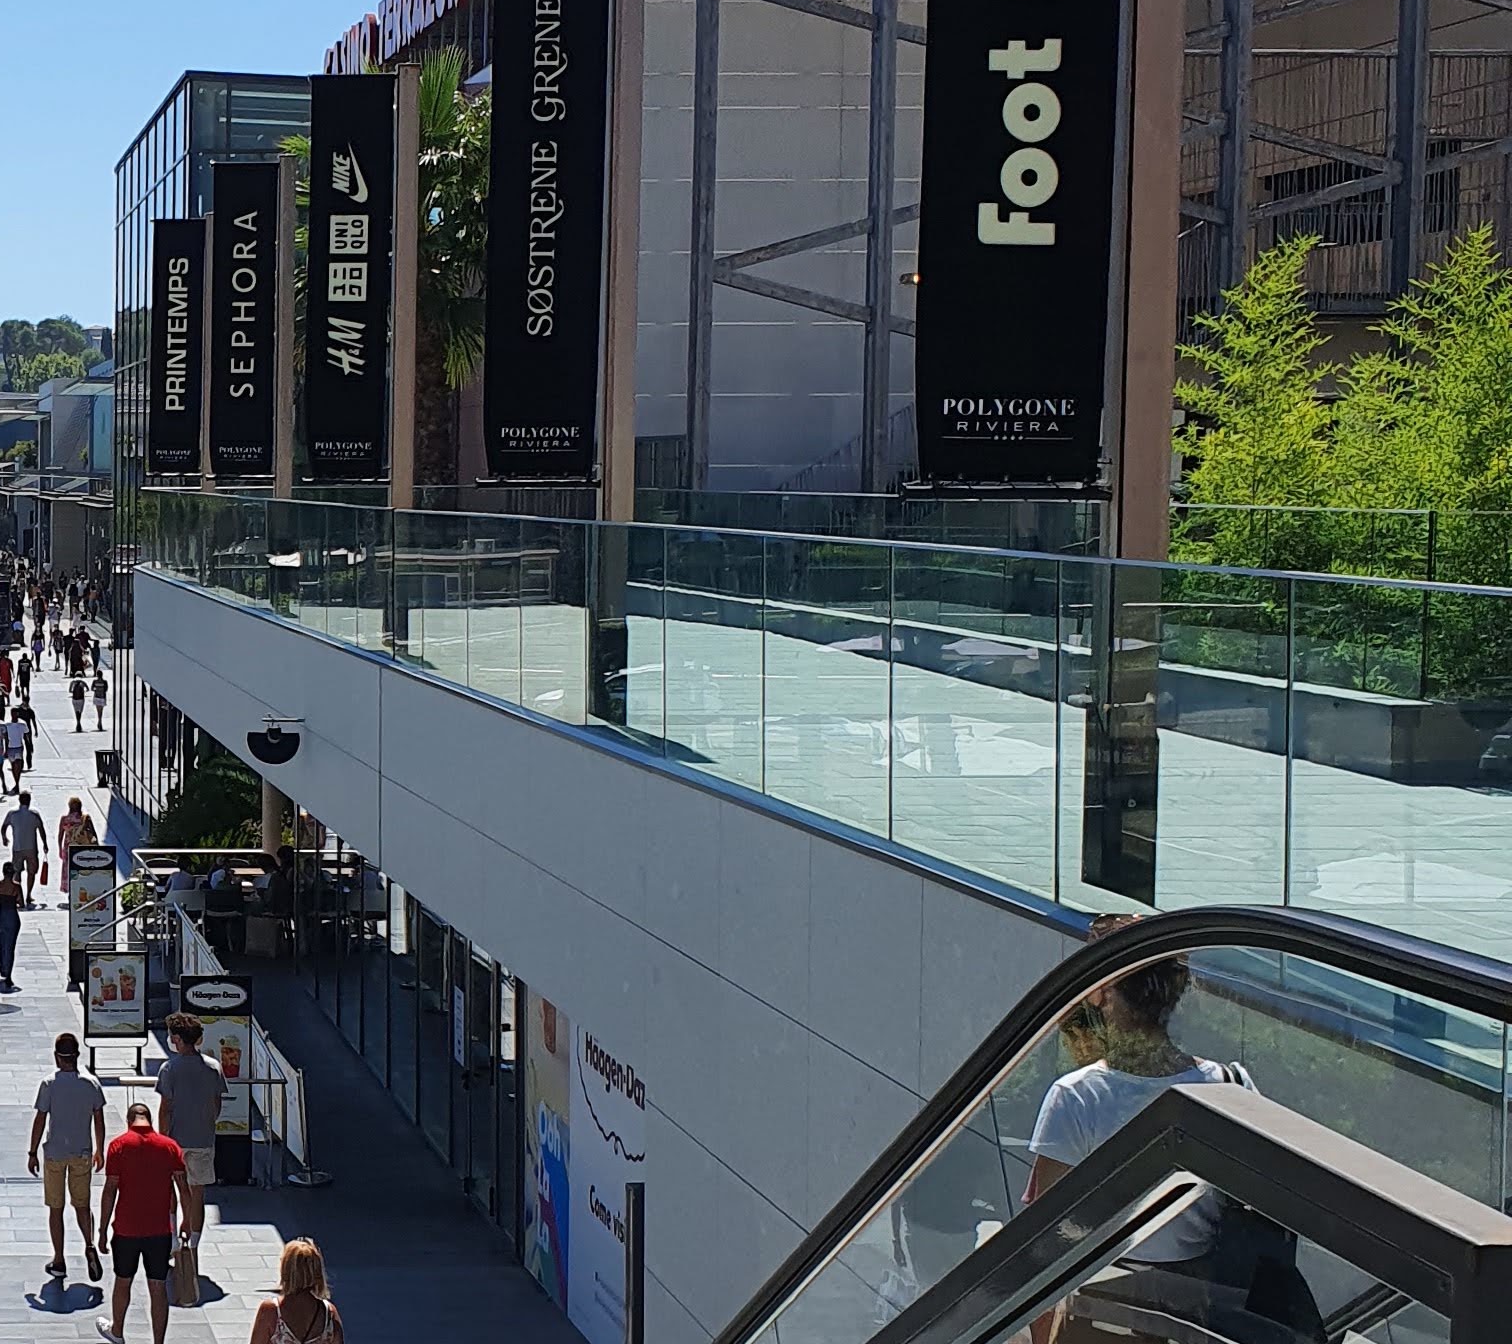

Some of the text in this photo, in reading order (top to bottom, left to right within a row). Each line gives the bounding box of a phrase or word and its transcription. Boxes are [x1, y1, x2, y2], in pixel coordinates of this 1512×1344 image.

[324, 14, 375, 74] CASINO
[332, 151, 350, 194] NIKE
[526, 139, 565, 337] SØSTRENE
[229, 211, 258, 398] SEPHORA
[165, 257, 189, 411] PRINTEMPS
[326, 316, 367, 376] H&M
[942, 397, 1076, 416] POLYGONE
[956, 421, 1060, 432] RIVIERA
[314, 441, 373, 450] POLYGONE
[500, 426, 580, 438] POLYGONE
[613, 1210, 626, 1244] vis
